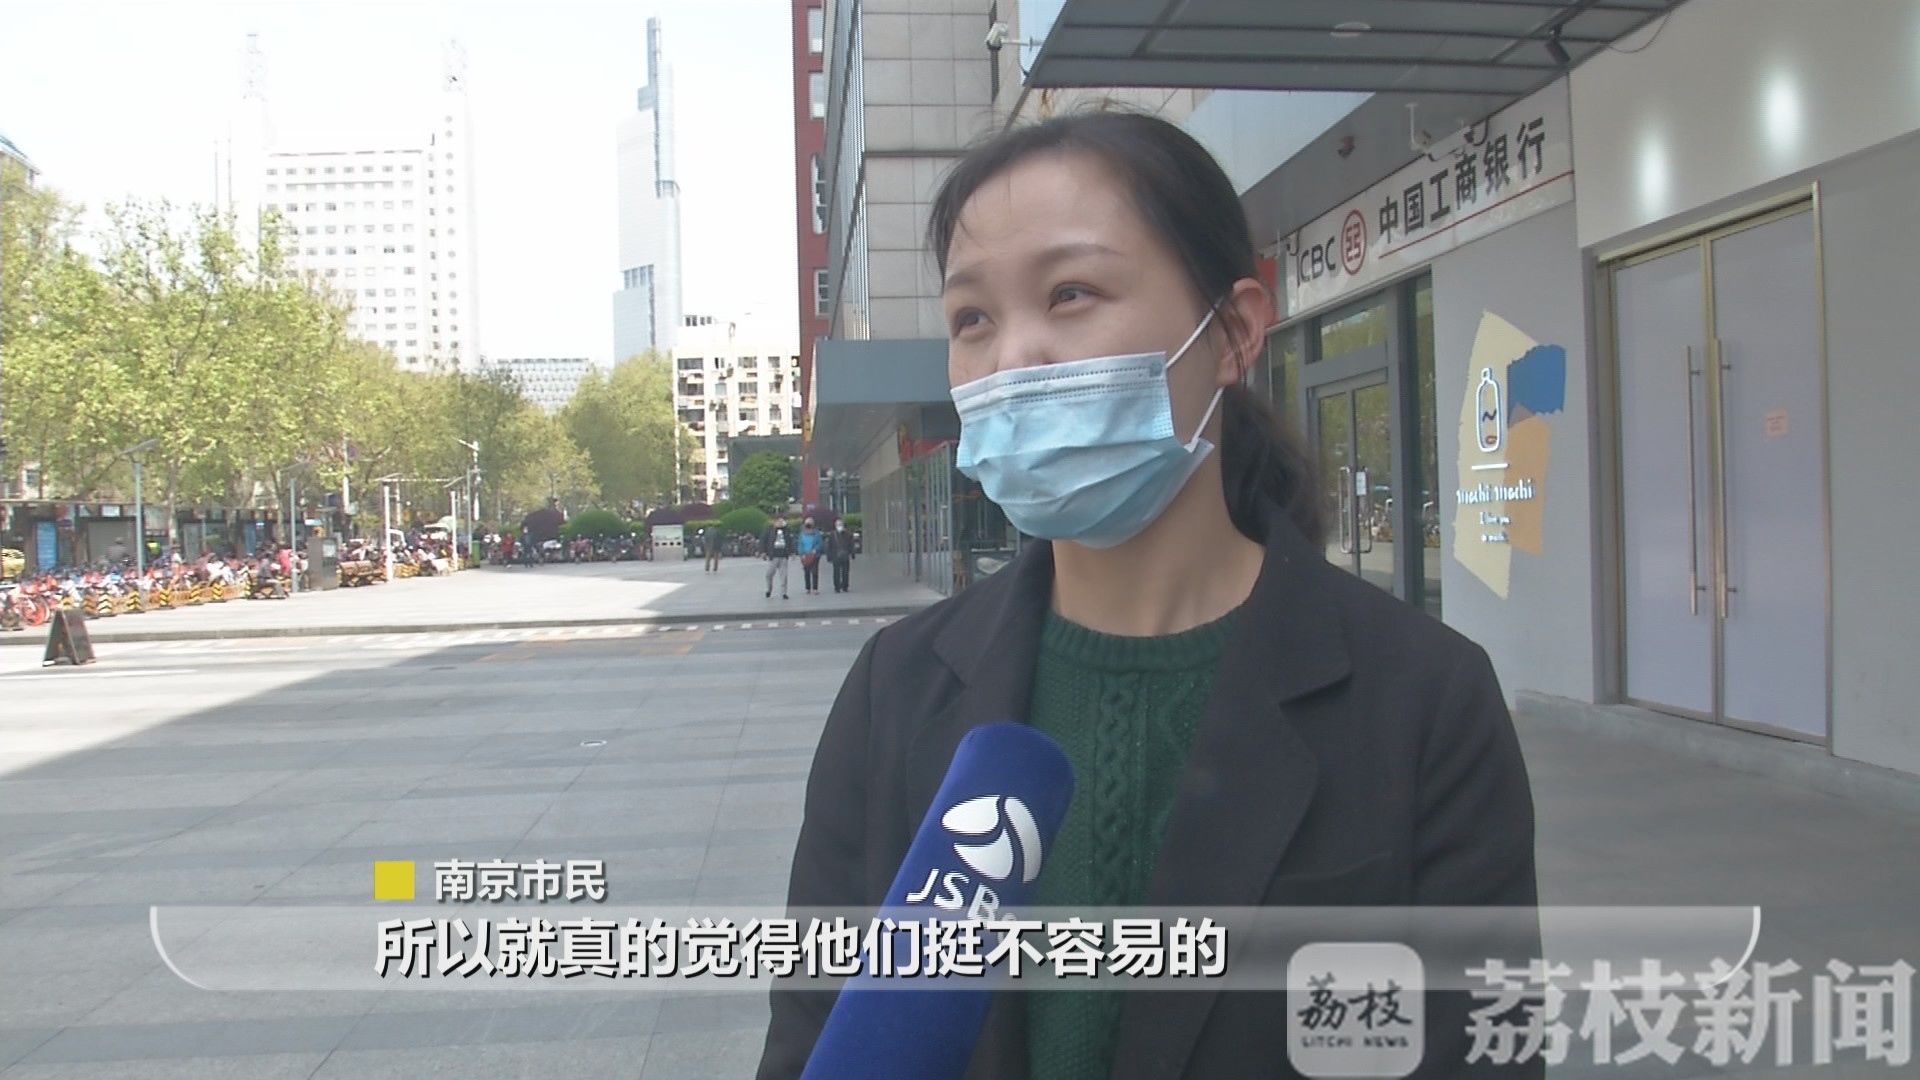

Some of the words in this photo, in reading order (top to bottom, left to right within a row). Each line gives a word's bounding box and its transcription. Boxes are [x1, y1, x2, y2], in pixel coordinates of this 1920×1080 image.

[1379, 116, 1545, 244] 中国工商银行
